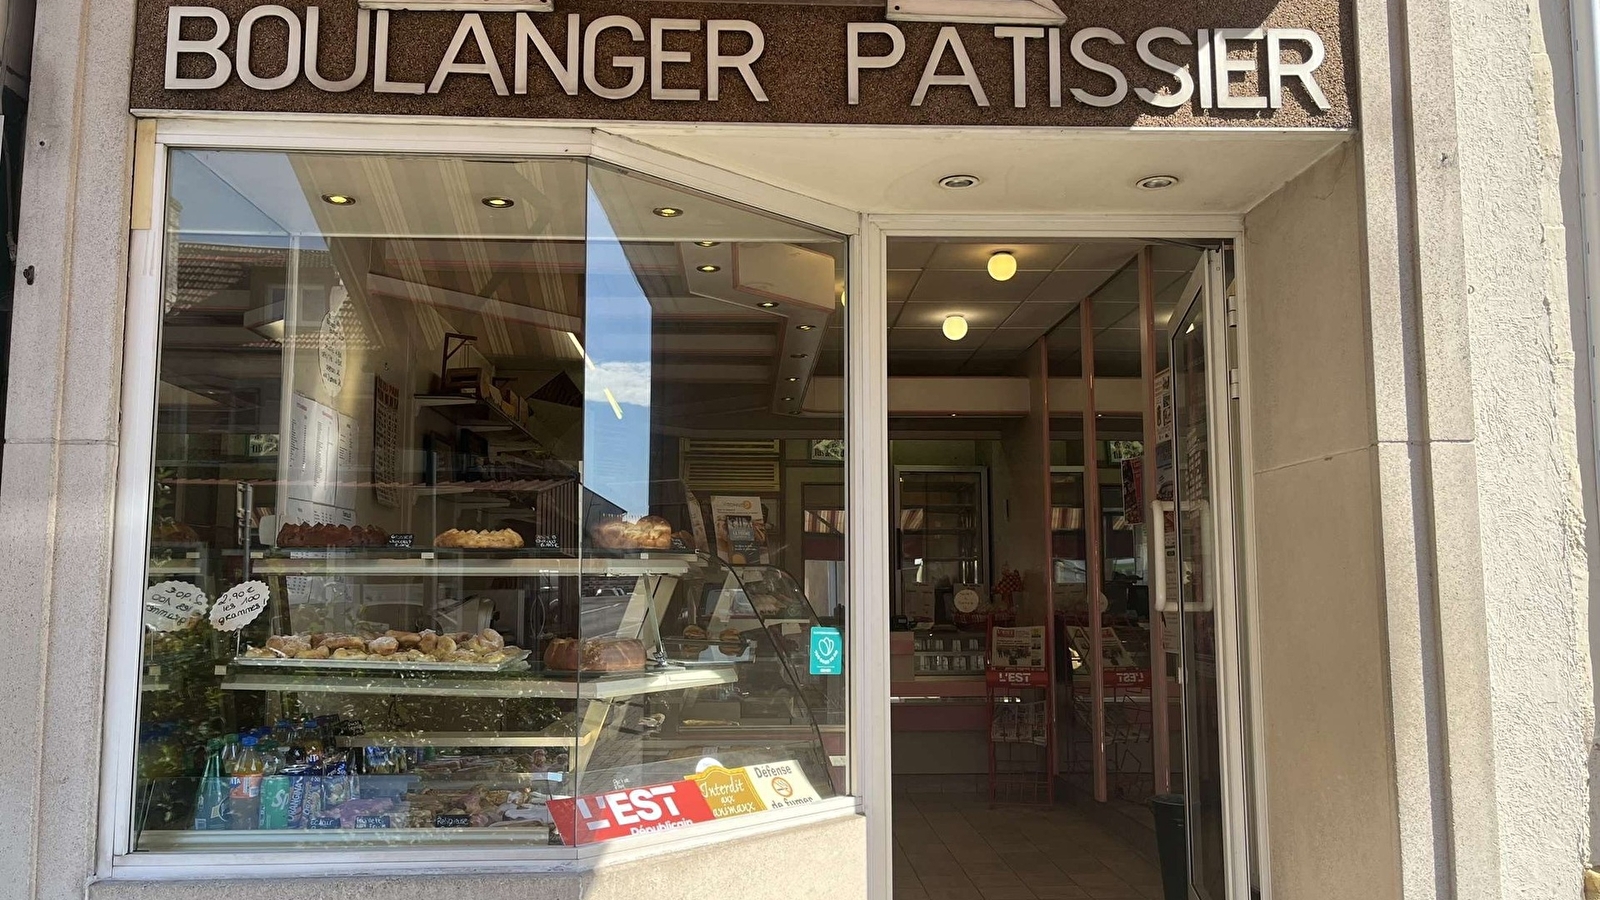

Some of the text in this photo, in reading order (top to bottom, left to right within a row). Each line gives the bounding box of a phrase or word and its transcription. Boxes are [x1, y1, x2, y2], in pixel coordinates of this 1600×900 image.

[164, 5, 1331, 111] BOULANGER PATISSIER
[222, 593, 261, 612] les 100
[218, 603, 260, 626] grammes
[999, 672, 1031, 683] L'EST
[753, 764, 793, 779] Défense
[700, 775, 745, 798] Interdit
[576, 784, 680, 831] L'EST
[720, 794, 735, 804] aux
[712, 802, 756, 818] animaux
